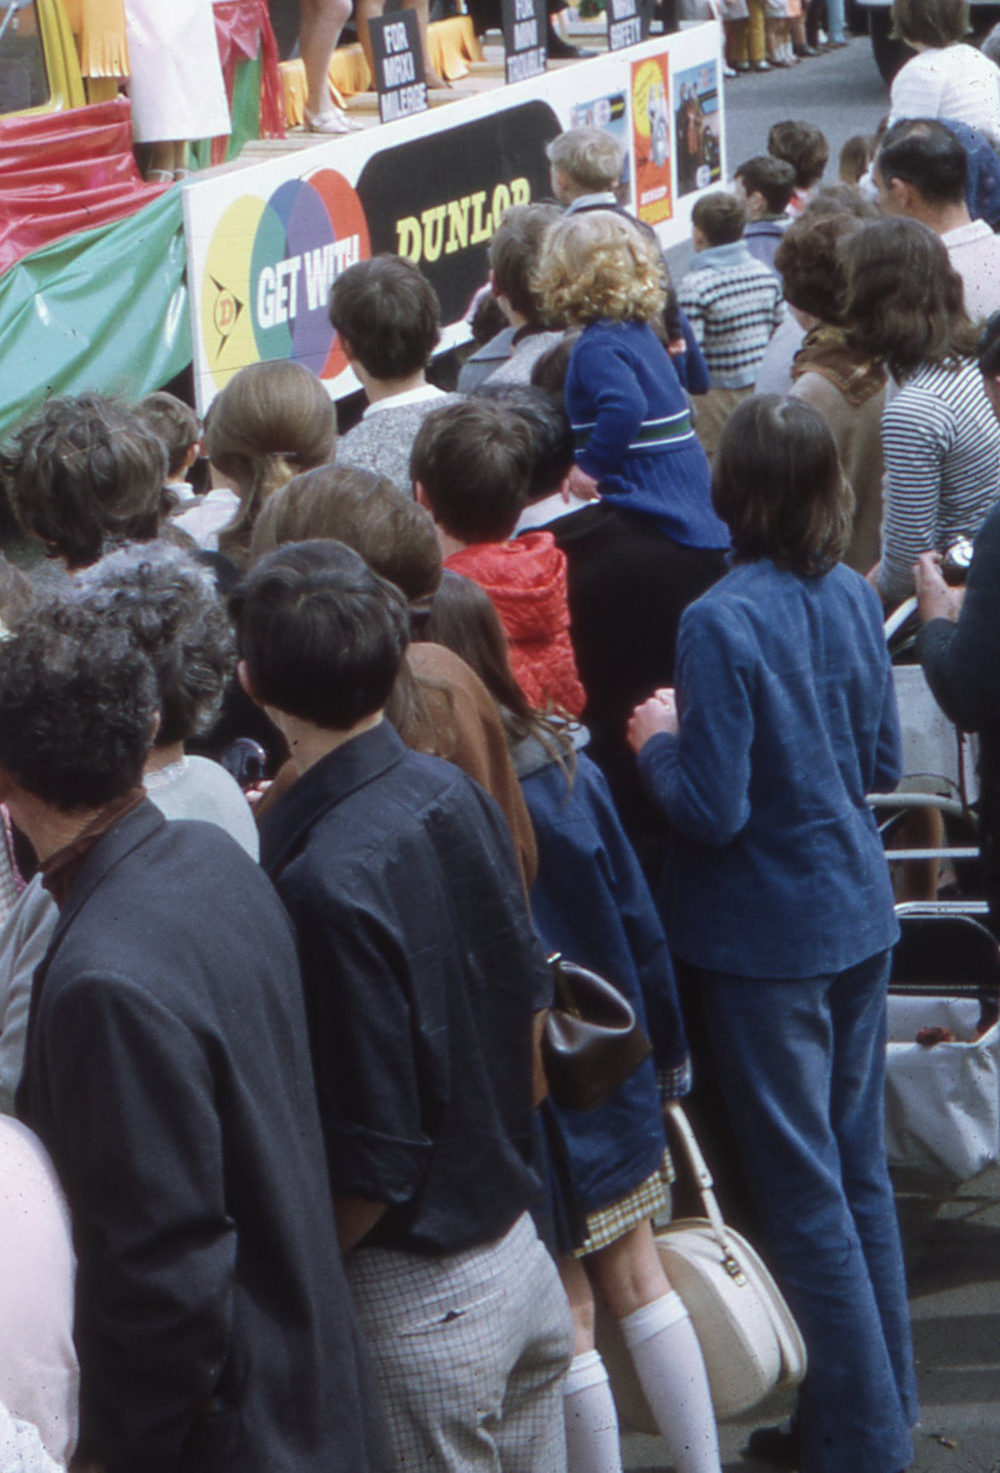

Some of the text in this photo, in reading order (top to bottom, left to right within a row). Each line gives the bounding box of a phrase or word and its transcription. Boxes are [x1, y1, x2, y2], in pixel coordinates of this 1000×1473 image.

[383, 21, 409, 54] FOR
[383, 51, 416, 88] MAXI
[257, 255, 302, 330] GET
[219, 298, 234, 327] D
